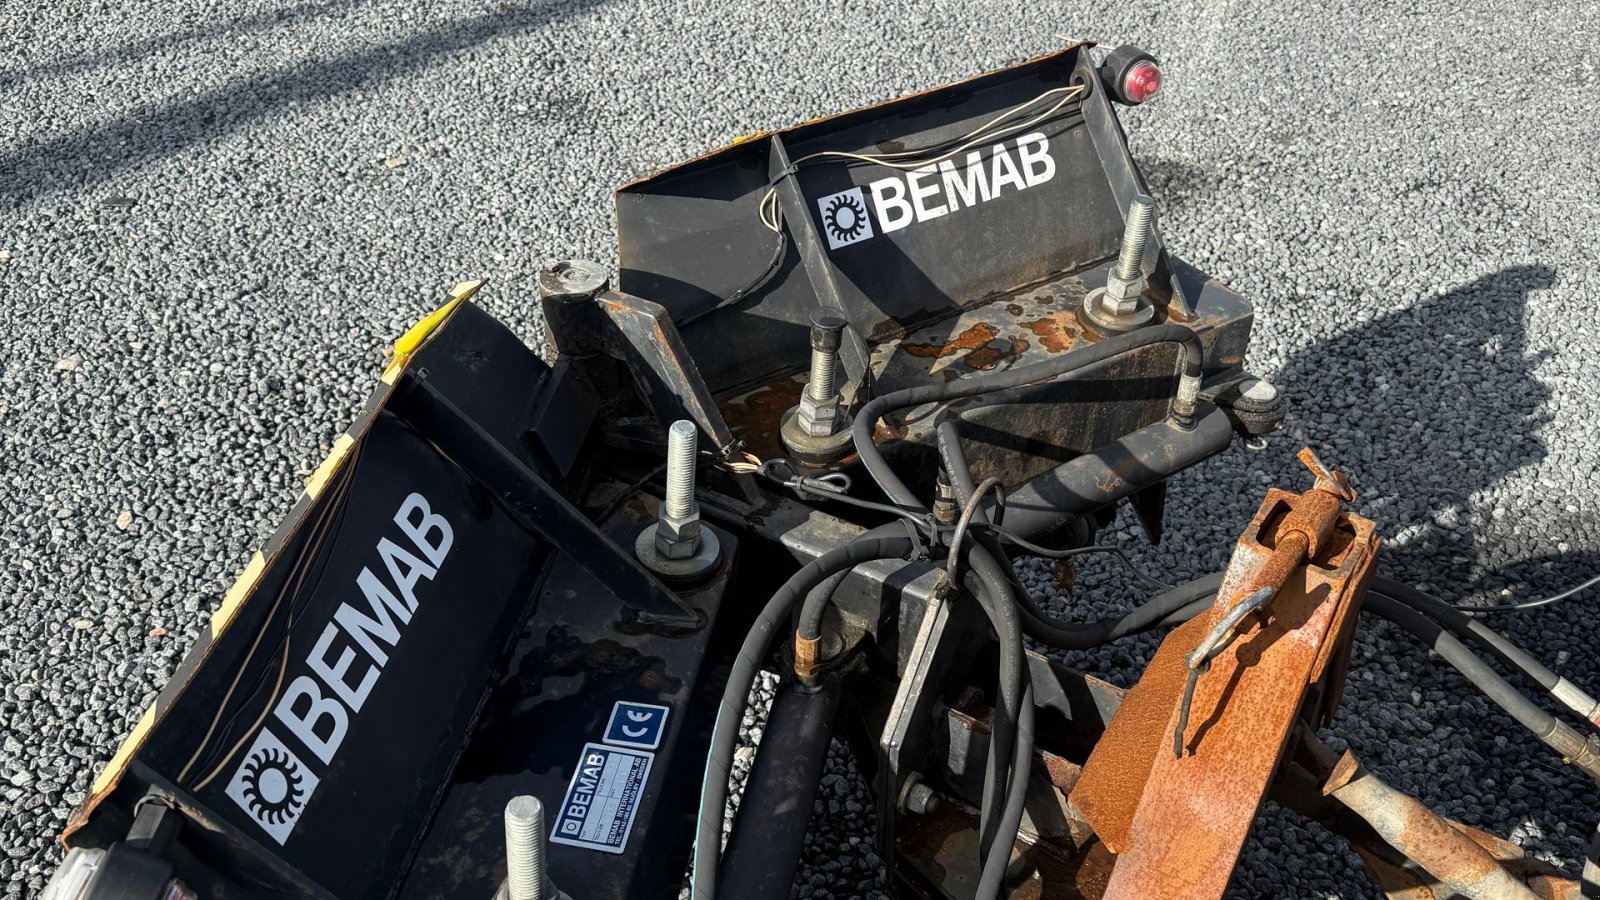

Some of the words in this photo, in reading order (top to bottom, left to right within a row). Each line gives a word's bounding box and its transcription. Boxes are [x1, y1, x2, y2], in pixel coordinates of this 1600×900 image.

[869, 132, 1056, 234] BEMAB
[275, 492, 454, 766] BEMAB
[568, 753, 605, 818] BEMAB
[607, 819, 621, 844] BEMAB
[616, 767, 638, 818] INTERNATIONAL
[633, 756, 642, 767] AB
[636, 758, 647, 779] SWEDEN
